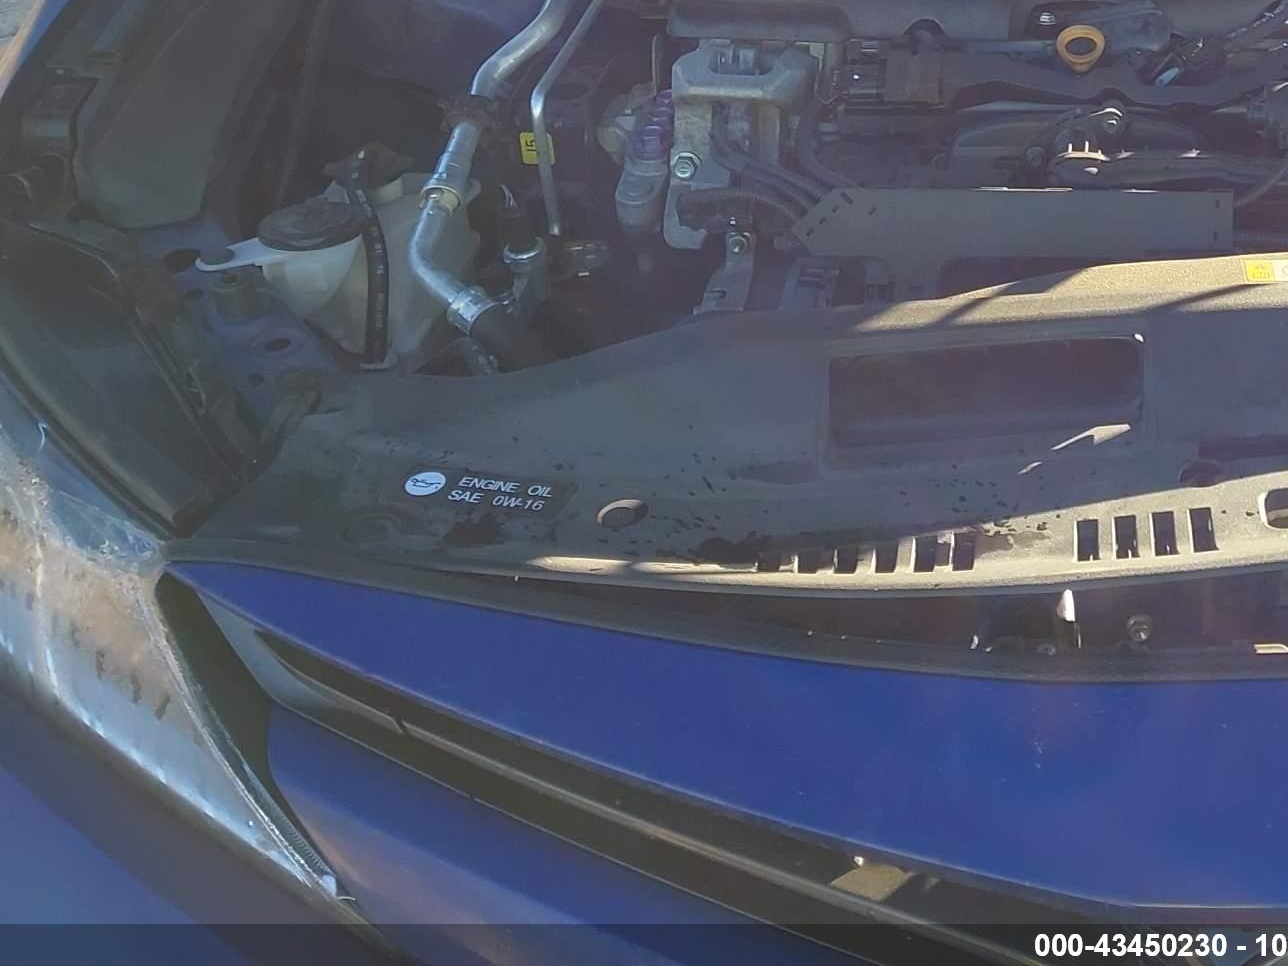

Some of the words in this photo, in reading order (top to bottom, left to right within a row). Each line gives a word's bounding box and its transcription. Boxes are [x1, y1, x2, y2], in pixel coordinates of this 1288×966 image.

[458, 476, 519, 493] ENGINE
[527, 484, 553, 497] OIL
[447, 489, 482, 503] SAE
[492, 495, 545, 511] 0W-16
